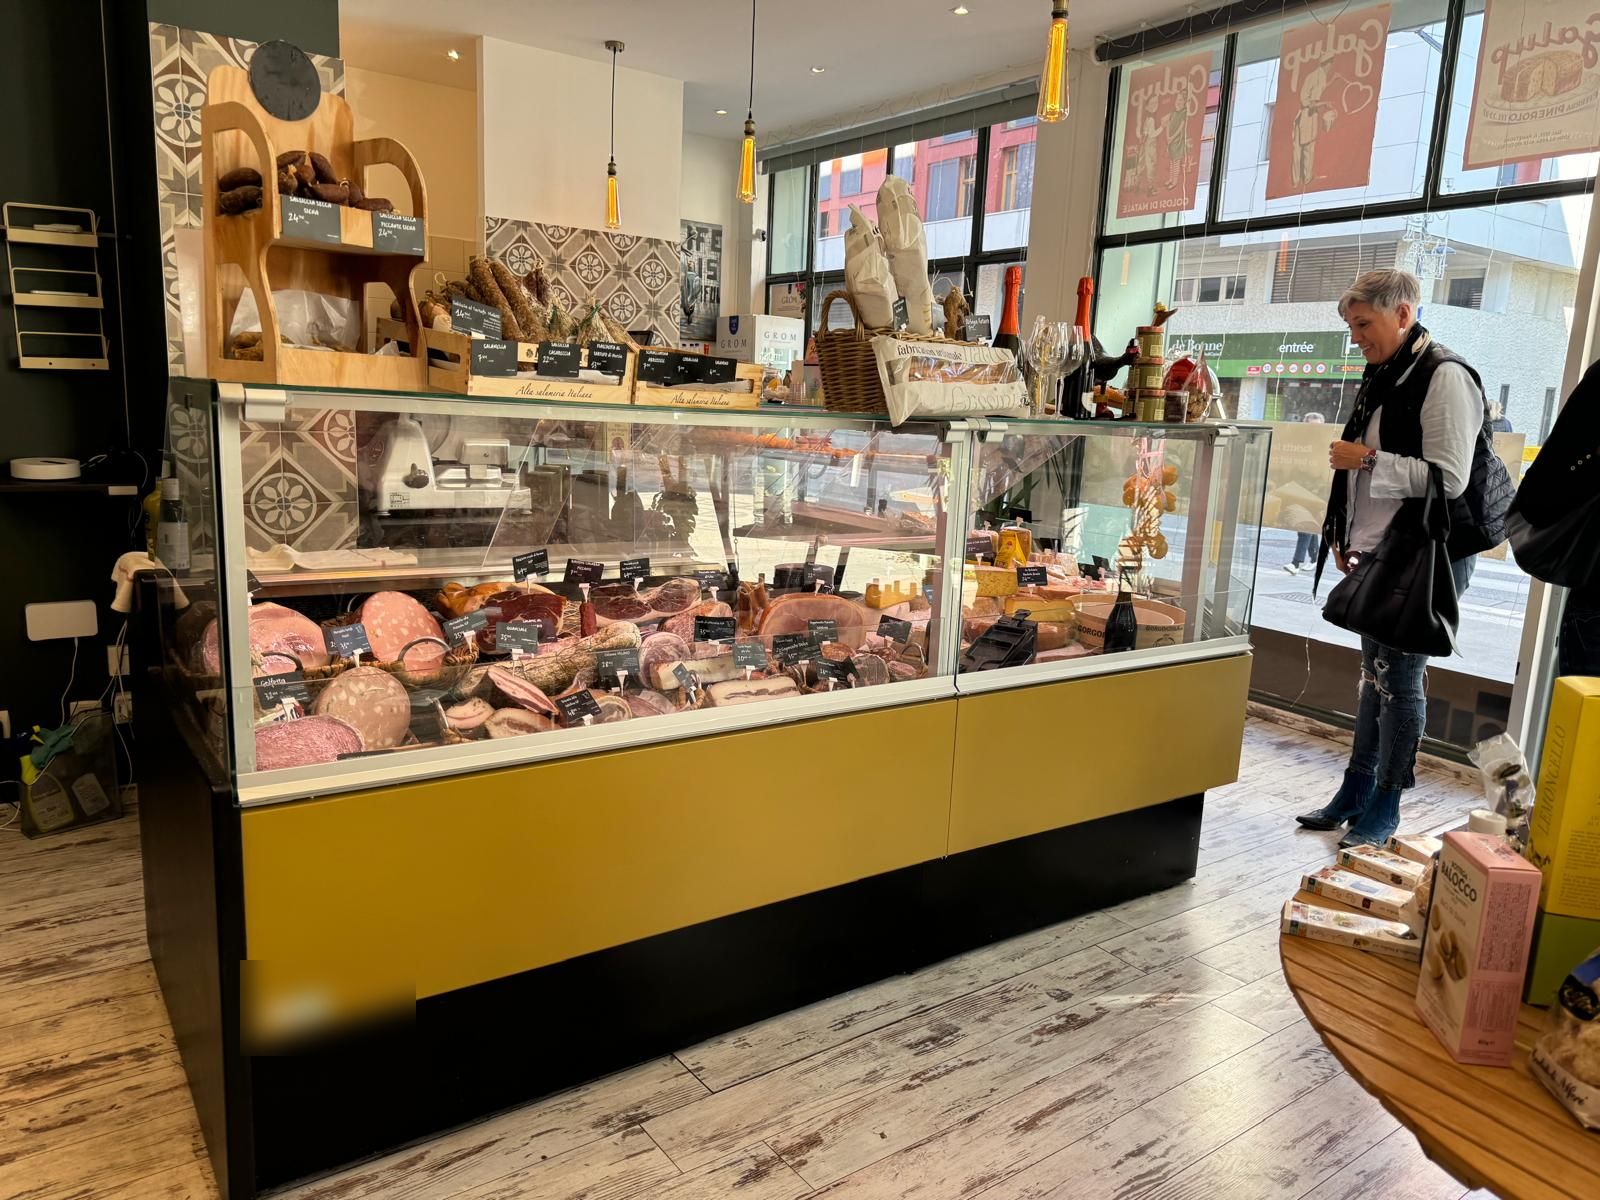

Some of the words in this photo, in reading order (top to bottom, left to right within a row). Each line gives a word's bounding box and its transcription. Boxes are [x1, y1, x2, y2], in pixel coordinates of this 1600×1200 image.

[763, 330, 797, 342] GROM
[720, 338, 747, 349] GROM
[1187, 338, 1223, 352] Bonne
[1279, 340, 1315, 353] entrée
[515, 383, 533, 396] Alta
[567, 385, 593, 399] Italiana
[670, 391, 686, 404] Alta
[709, 394, 730, 406] Italiana
[1441, 861, 1478, 903] BALOCCO
